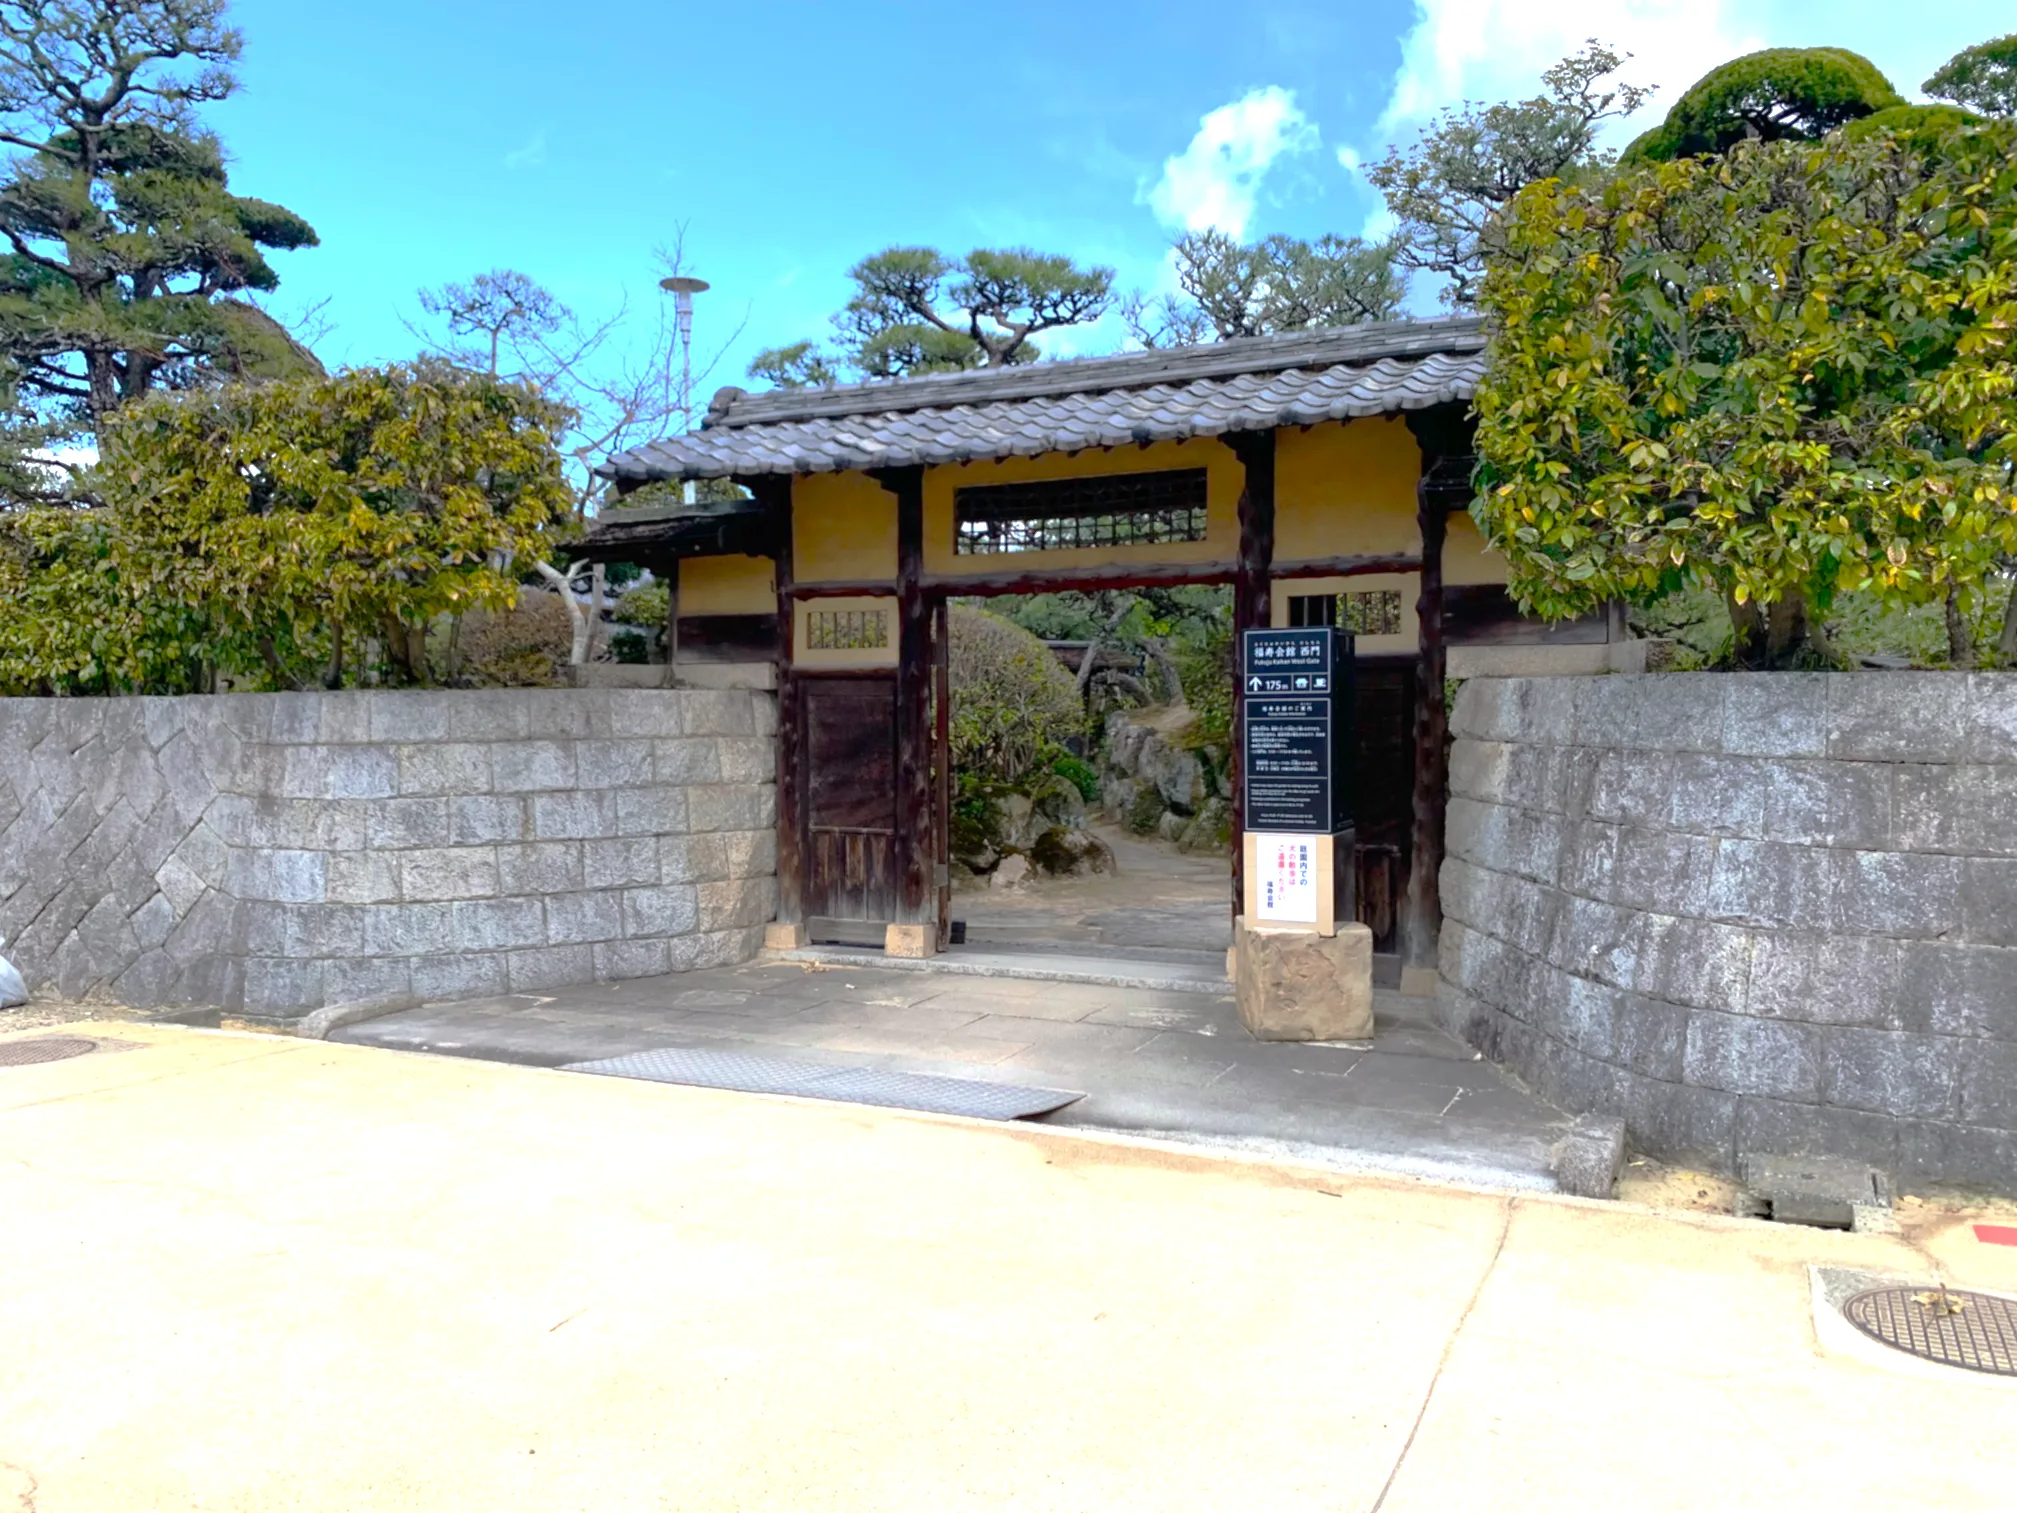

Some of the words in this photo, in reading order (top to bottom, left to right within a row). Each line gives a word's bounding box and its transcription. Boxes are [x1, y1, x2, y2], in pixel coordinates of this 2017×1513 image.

[1254, 646, 1296, 658] 福寿会館
[1300, 646, 1320, 657] 西門
